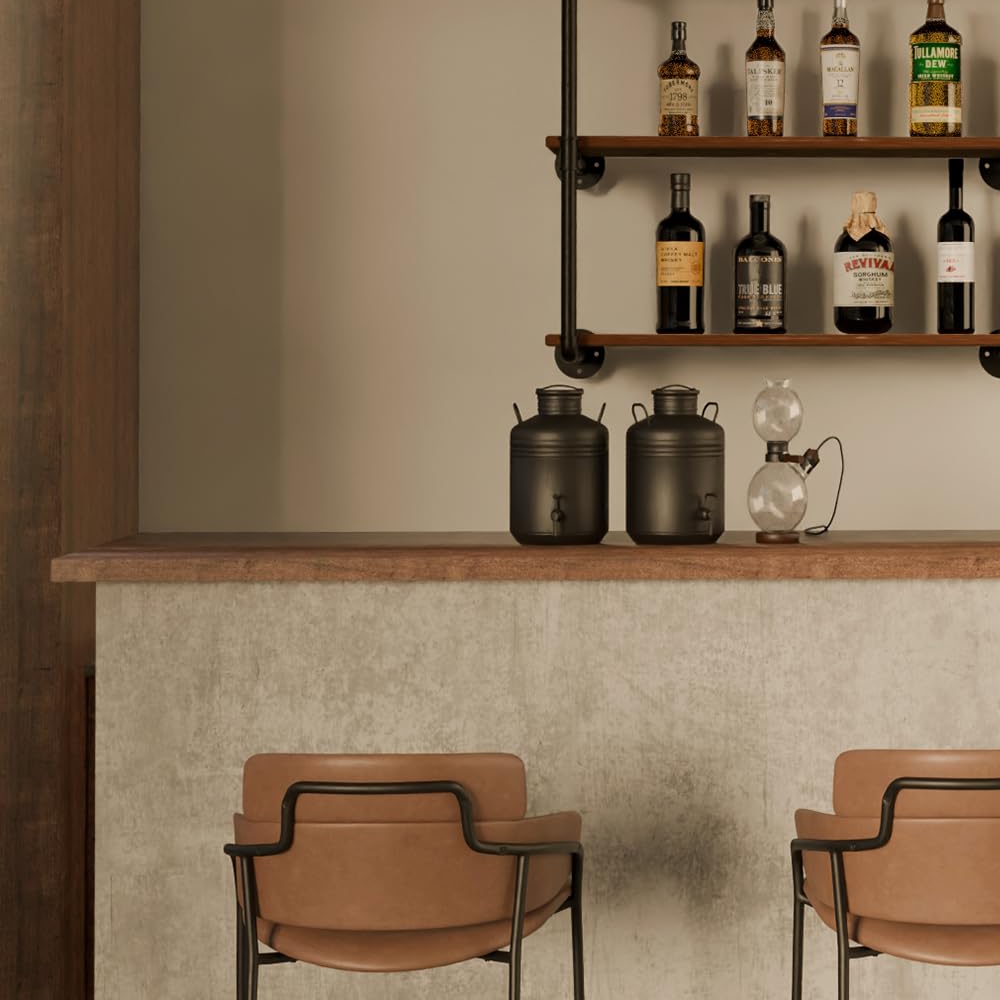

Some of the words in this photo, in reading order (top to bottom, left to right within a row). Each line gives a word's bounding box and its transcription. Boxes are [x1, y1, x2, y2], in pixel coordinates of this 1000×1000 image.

[914, 46, 959, 59] TULLAMORE
[925, 60, 947, 68] DEW
[670, 92, 688, 102] 1798
[762, 283, 783, 295] BLUE
